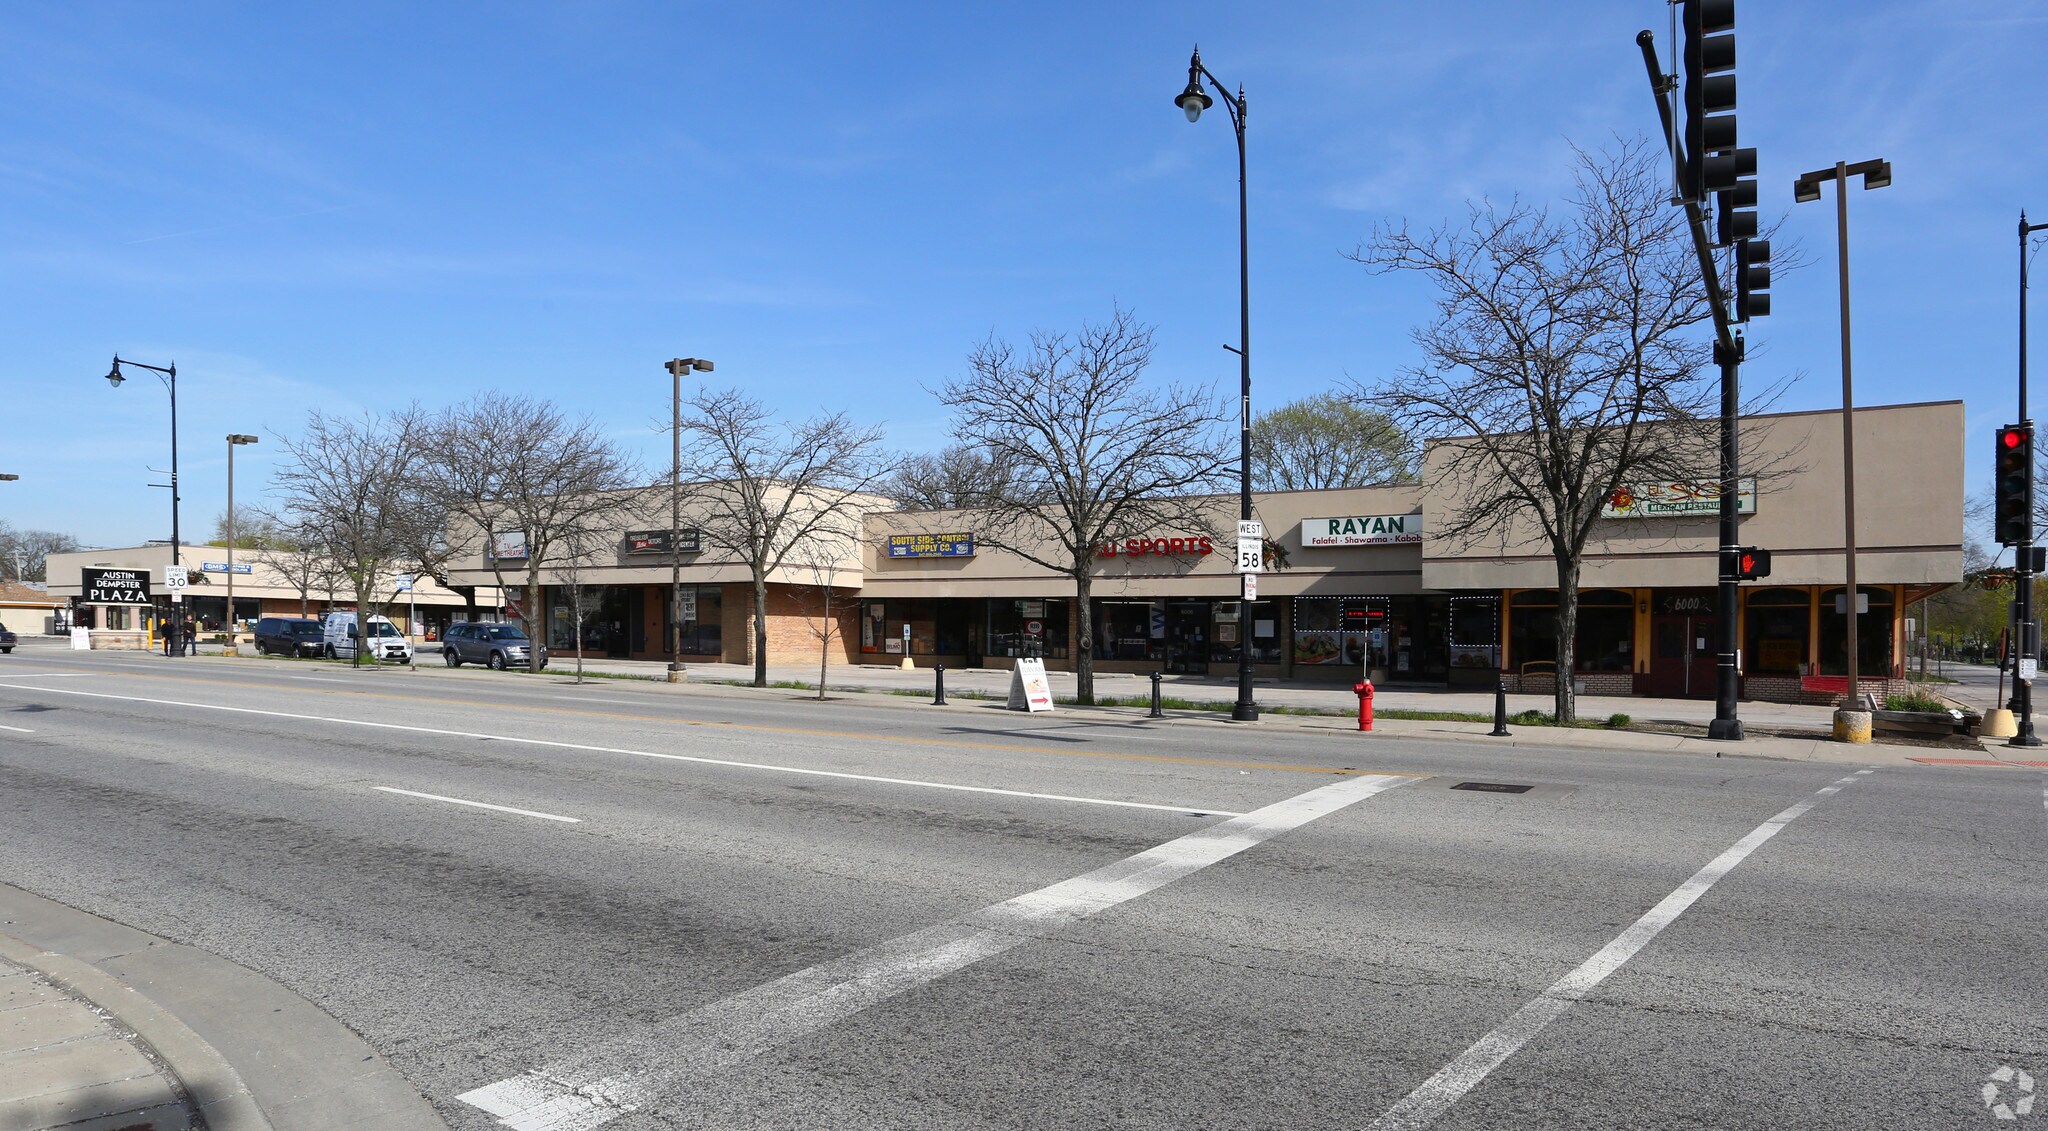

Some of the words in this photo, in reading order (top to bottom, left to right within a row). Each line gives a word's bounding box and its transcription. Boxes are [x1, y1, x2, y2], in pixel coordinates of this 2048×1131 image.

[1650, 502, 1686, 511] MEXICAN
[1240, 524, 1261, 534] WEST
[1328, 516, 1404, 535] RAYAN
[891, 536, 915, 546] SOUTH
[917, 535, 935, 545] SIDE
[1312, 536, 1338, 545] Falafel
[1344, 535, 1388, 544] Shawarma
[910, 544, 938, 552] SUPPLY
[940, 543, 952, 552] CO.
[1126, 536, 1213, 557] SPORTS
[1242, 552, 1259, 568] 58
[102, 571, 135, 580] AUSTIN
[96, 579, 141, 589] DEMPSTER
[168, 578, 186, 587] 30
[90, 589, 147, 602] PLAZA
[1674, 598, 1700, 610] 6000
